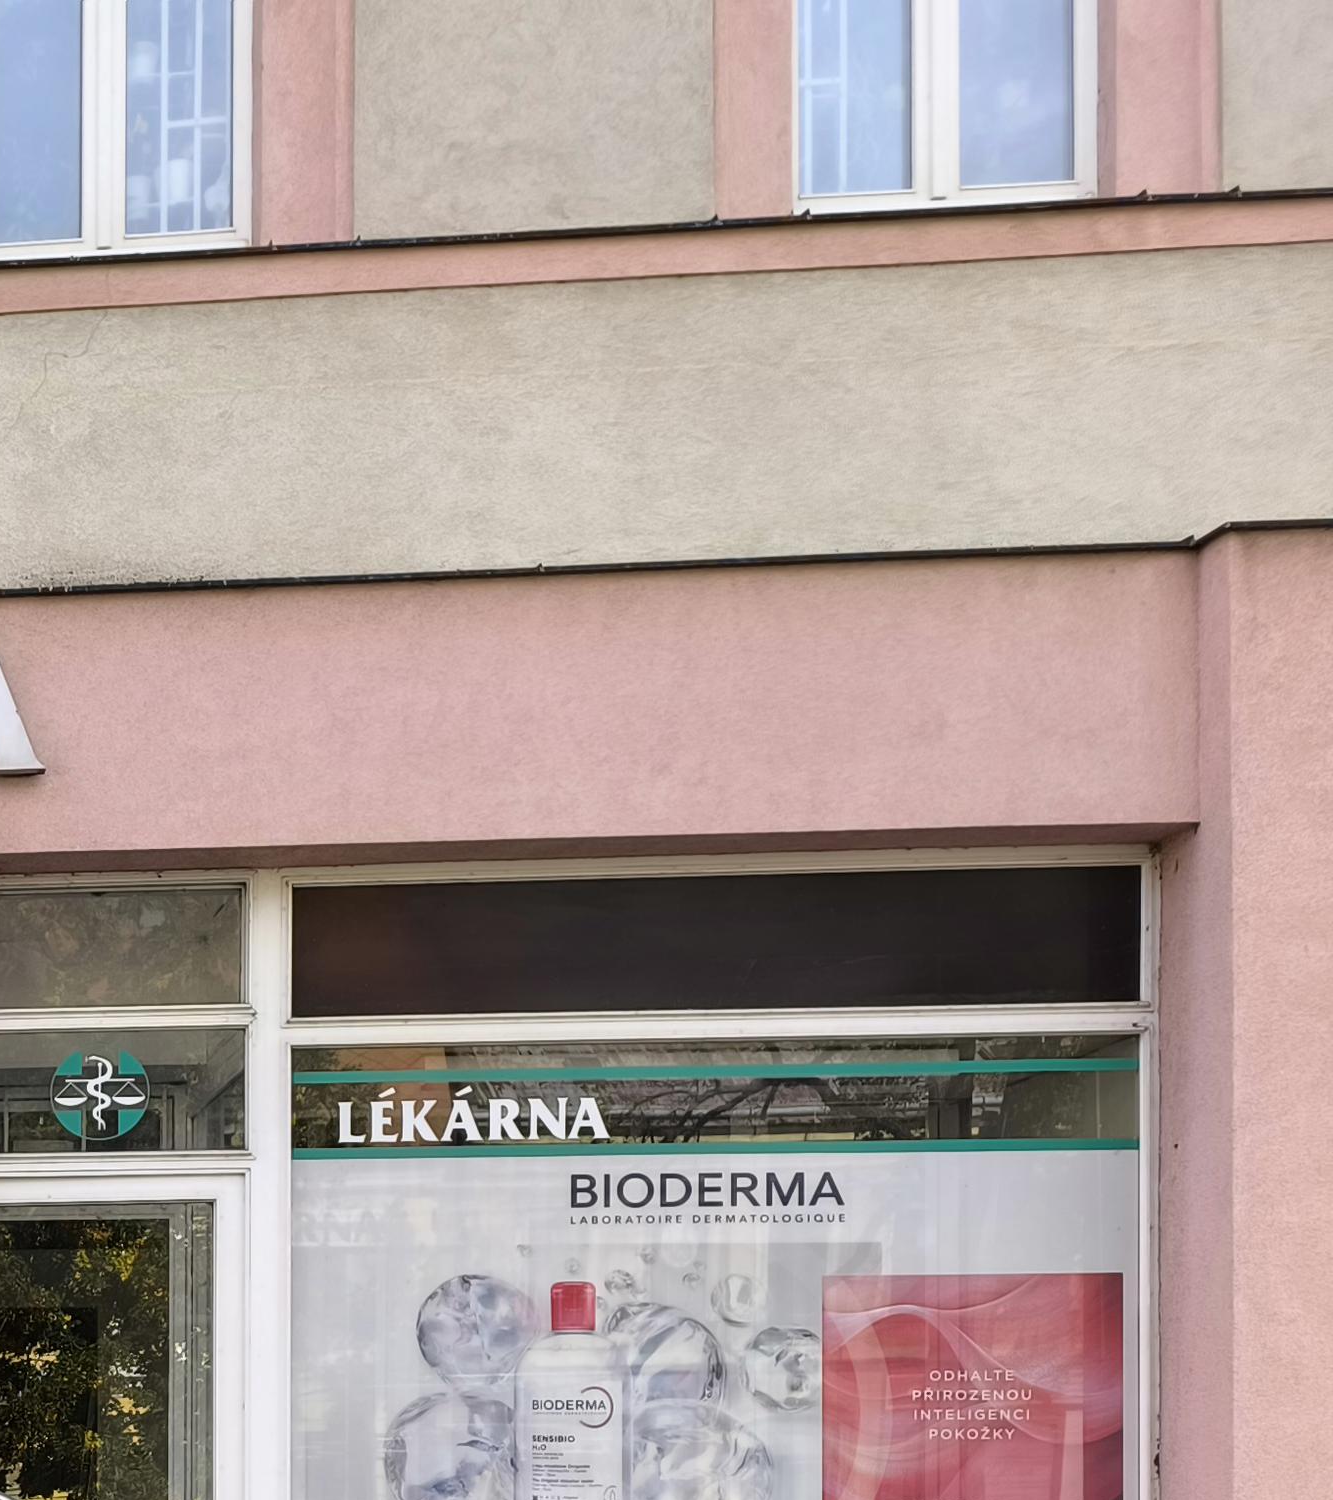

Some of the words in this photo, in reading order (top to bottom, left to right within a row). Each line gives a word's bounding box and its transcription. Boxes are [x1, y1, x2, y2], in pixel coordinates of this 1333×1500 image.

[338, 1085, 611, 1144] LÉKÁRNA
[570, 1171, 846, 1208] BIODERMA
[570, 1214, 683, 1225] LABORATOIRE
[692, 1213, 846, 1224] DERMATOLOGIQUE
[929, 1370, 1015, 1381] ODHALTE
[911, 1387, 1032, 1401] PŘIROZENOU
[532, 1399, 607, 1410] BIODERMA
[913, 1409, 1030, 1420] INTELIGENCI
[532, 1435, 575, 1443] SENSIBIO
[929, 1426, 1015, 1440] POKOŽKY
